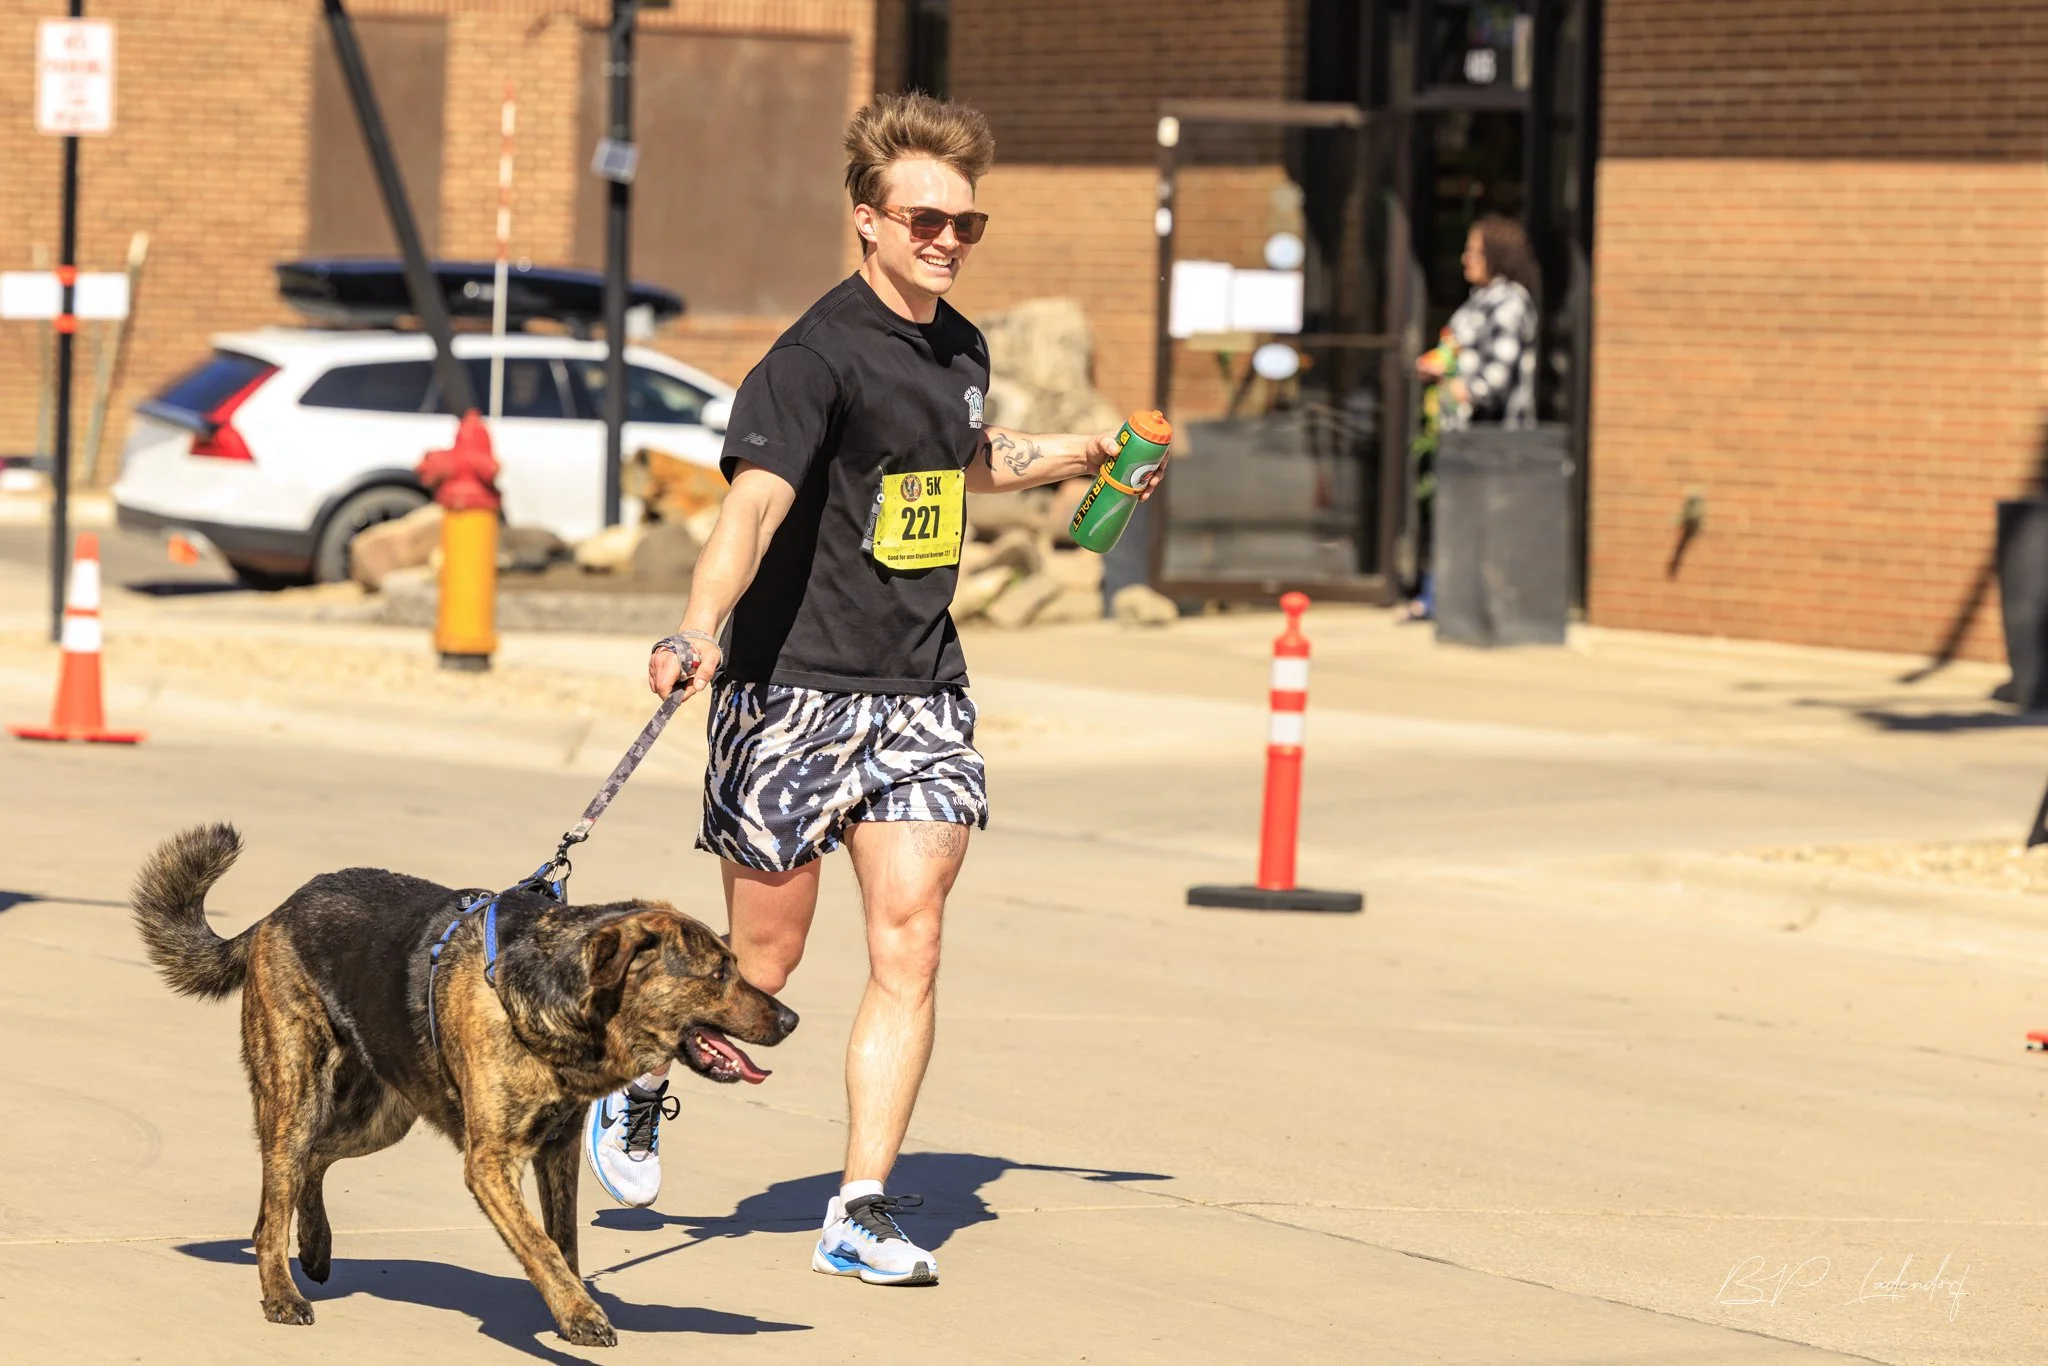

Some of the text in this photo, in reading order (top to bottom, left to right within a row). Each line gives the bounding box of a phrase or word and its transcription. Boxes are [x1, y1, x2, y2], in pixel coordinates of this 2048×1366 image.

[926, 477, 941, 496] 5K
[901, 505, 940, 541] 227
[1072, 494, 1096, 532] VALET
